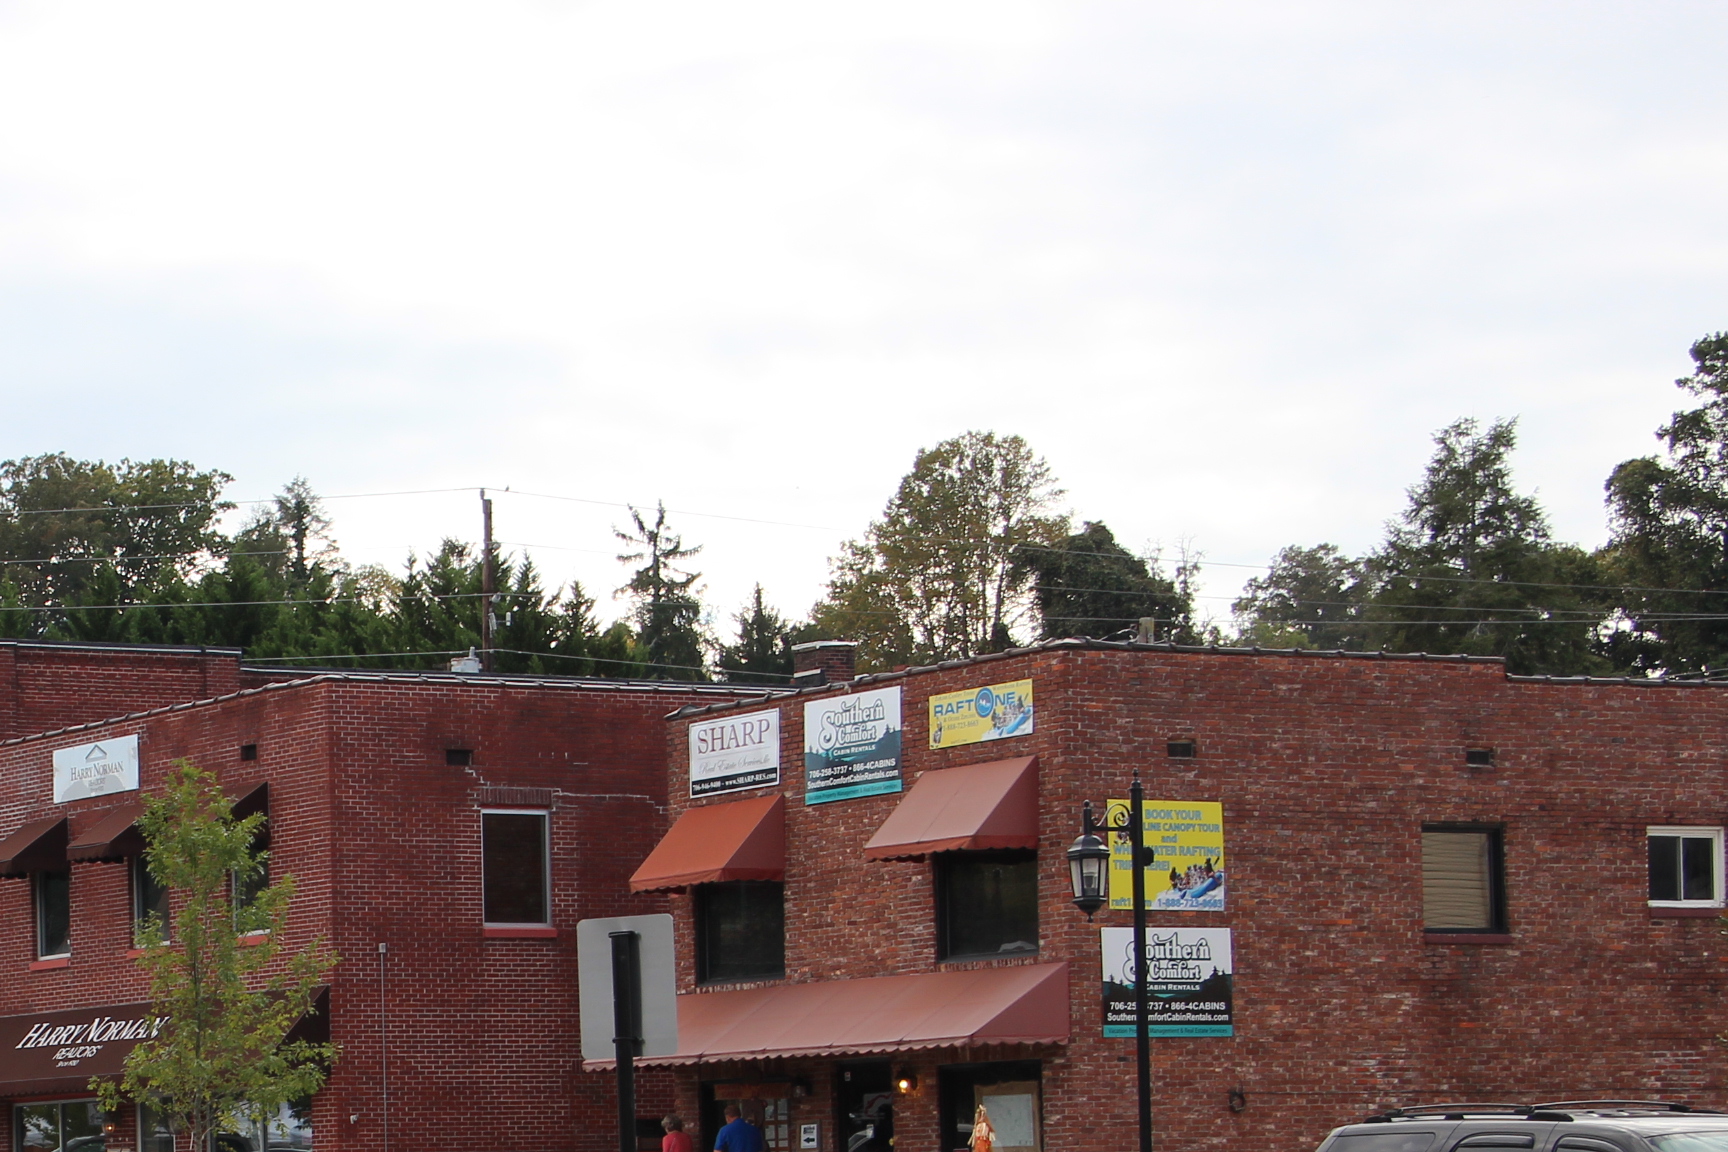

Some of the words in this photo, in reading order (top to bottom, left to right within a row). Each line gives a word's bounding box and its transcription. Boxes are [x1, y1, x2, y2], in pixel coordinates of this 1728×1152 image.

[818, 696, 885, 751] Southern
[697, 719, 770, 754] SHARP
[837, 723, 877, 745] Comfort
[833, 748, 850, 756] CABIN
[851, 744, 876, 754] RENTALS
[70, 767, 92, 782] HARRY
[93, 761, 124, 778] NORMAN
[807, 769, 899, 790] SouthernComfortCabinRentals.com
[1144, 809, 1173, 819] BOOK
[1174, 809, 1202, 820] YOUR
[1162, 823, 1195, 832] CANOPY
[1196, 823, 1220, 833] TOUR
[1161, 834, 1178, 843] and
[1179, 846, 1221, 857] RAFTING
[1149, 960, 1202, 980] Comfort
[1109, 1001, 1164, 1011] 706-25737
[1170, 1001, 1227, 1011] 866-4CABINS
[1107, 1012, 1229, 1022] SouthernmfortCabinRentals.com
[15, 1022, 89, 1049] HARRY
[75, 1016, 171, 1045] NORMAN
